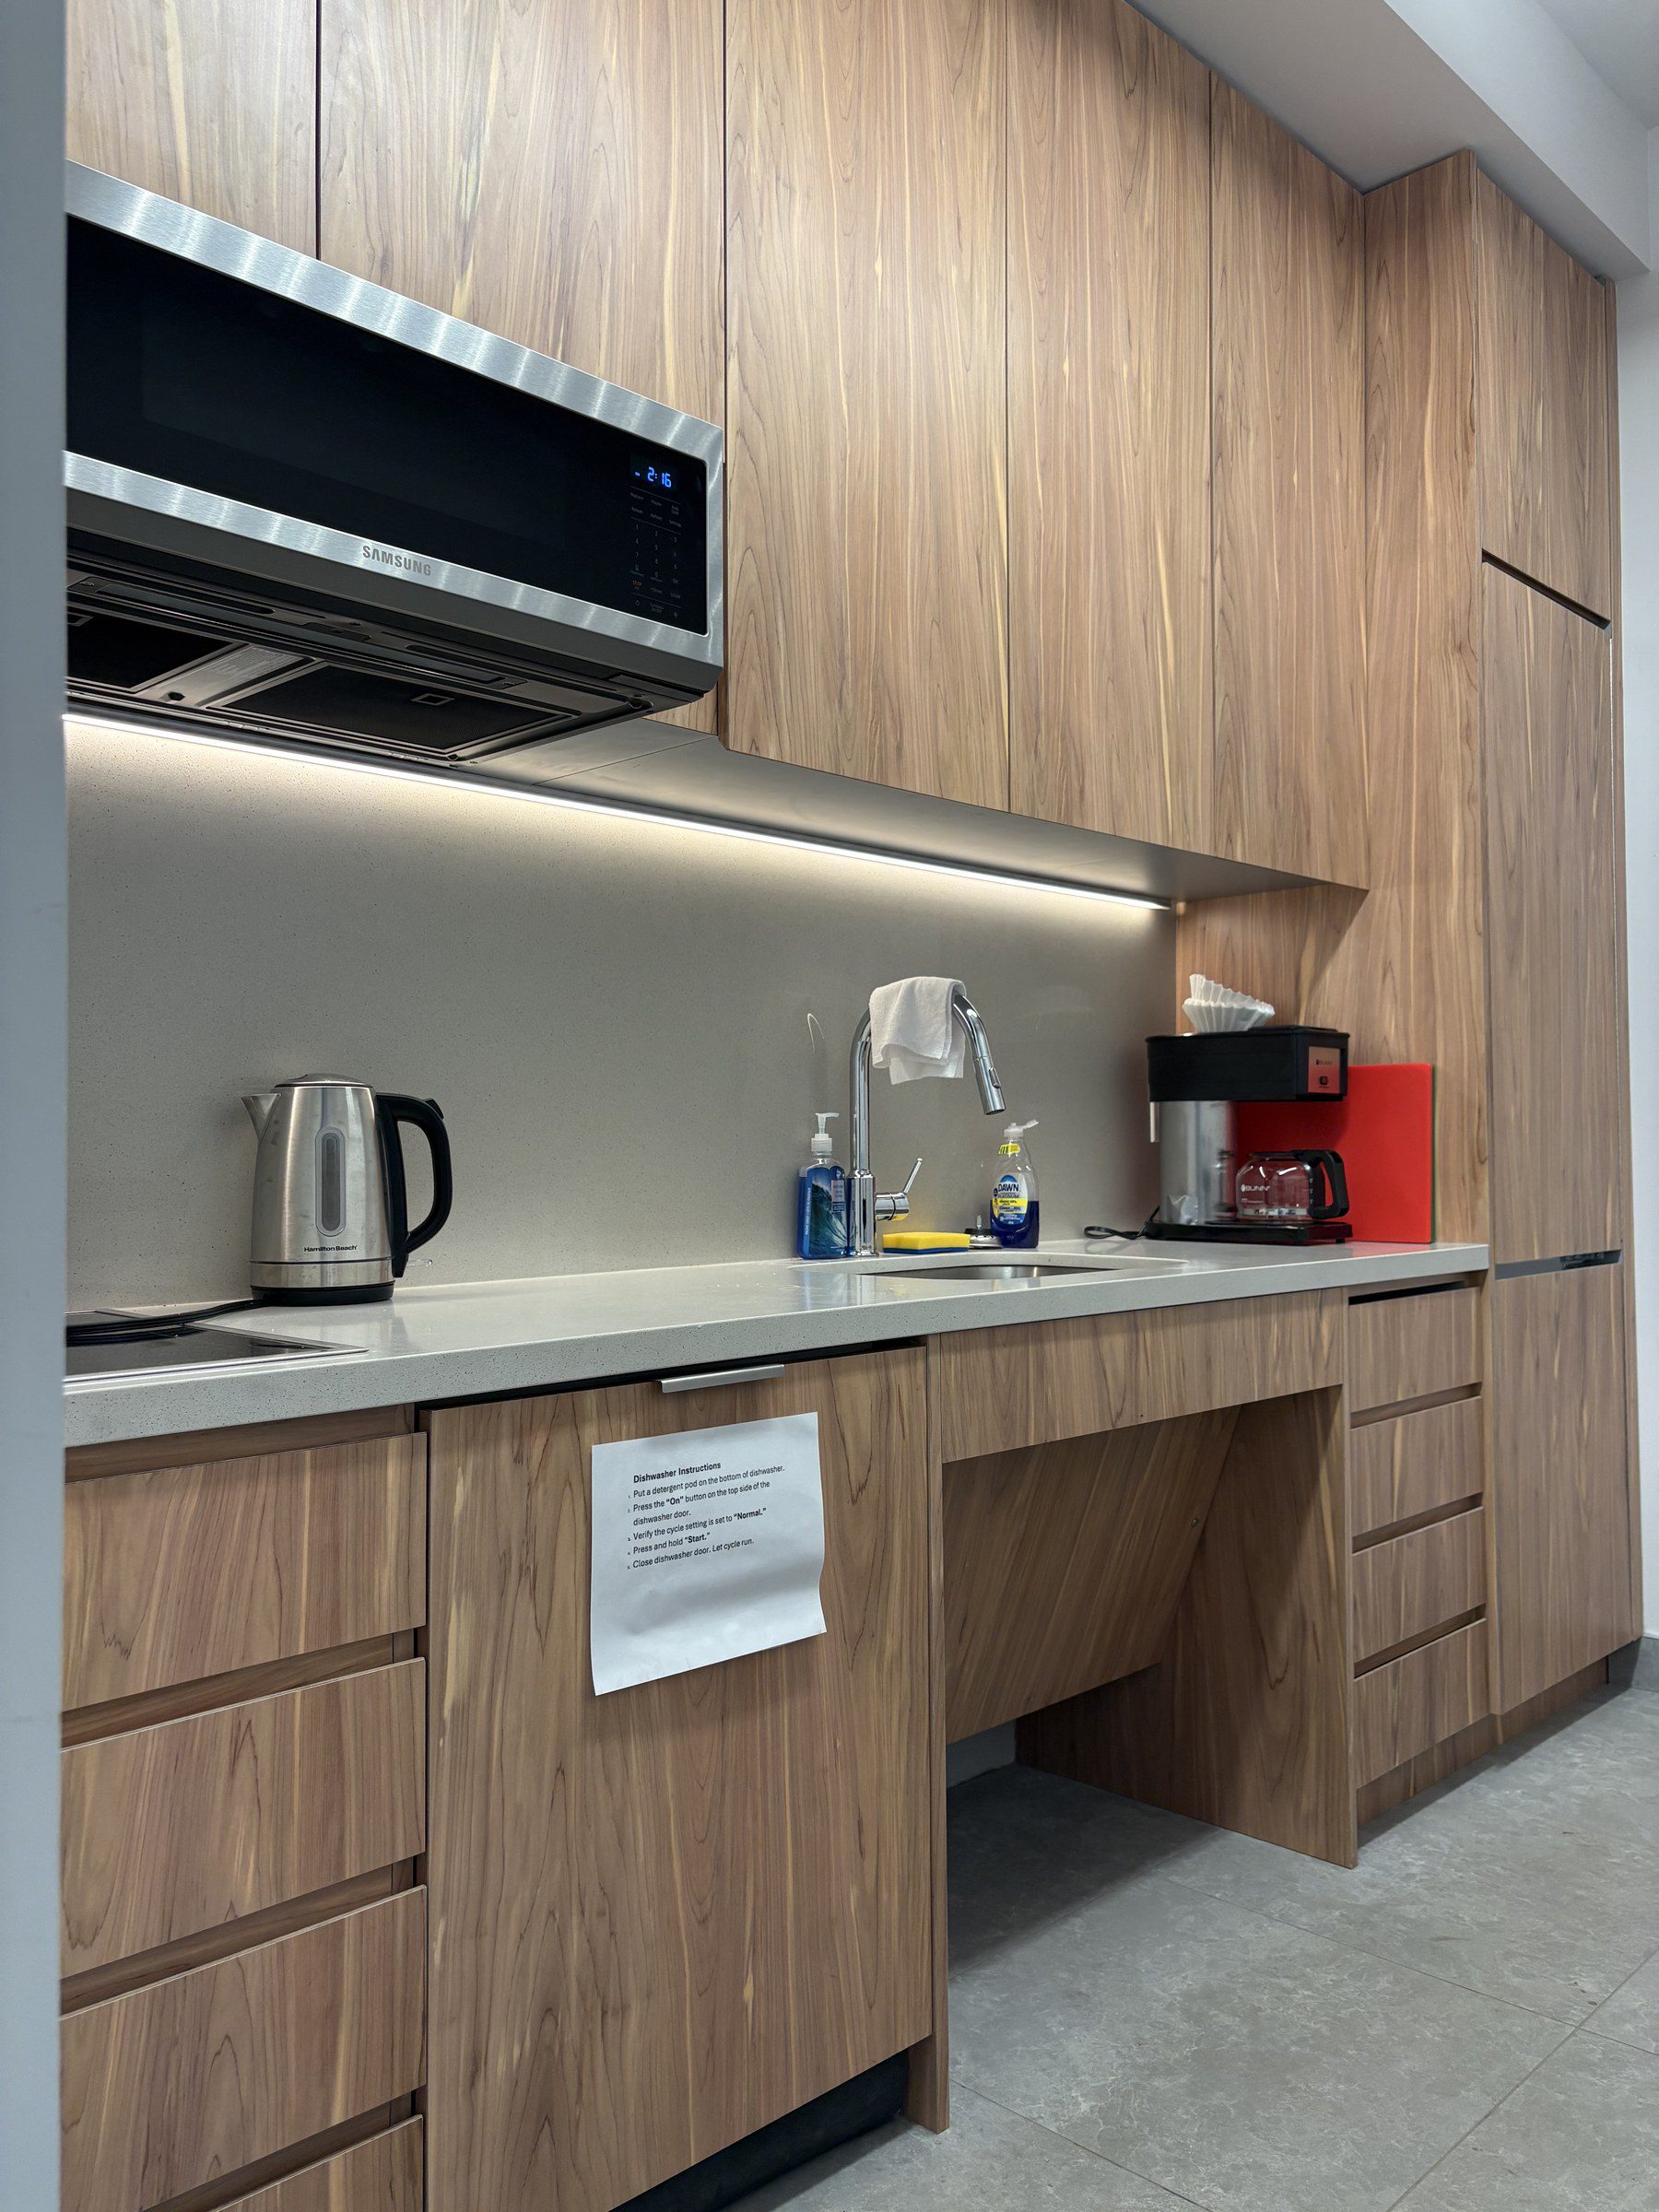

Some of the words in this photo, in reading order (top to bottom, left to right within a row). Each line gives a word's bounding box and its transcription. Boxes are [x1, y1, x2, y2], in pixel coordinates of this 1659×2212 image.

[362, 545, 431, 576] SAMSUNG
[998, 1184, 1019, 1192] DAWN
[634, 1470, 676, 1483] Dishwasher
[678, 1463, 721, 1475] Instructions
[652, 1483, 683, 1494] detergent
[685, 1480, 697, 1490] pod
[719, 1473, 741, 1482] bottom
[749, 1465, 785, 1477] dishwasher.
[633, 1503, 652, 1512] Press
[666, 1496, 684, 1505] “On”
[685, 1493, 706, 1502] button
[728, 1487, 738, 1496] top
[740, 1484, 752, 1492] side
[633, 1513, 672, 1526] dishwasher
[674, 1510, 691, 1519] door.
[633, 1530, 653, 1540] Verify
[667, 1524, 684, 1535] cycle
[685, 1520, 707, 1530] setting
[734, 1507, 766, 1520] “Normal.”
[633, 1545, 652, 1554] Press
[654, 1541, 667, 1550] and
[668, 1539, 683, 1547] hold
[685, 1532, 710, 1543] “Start.”
[633, 1559, 653, 1568] Close
[654, 1551, 693, 1564] dishwasher
[694, 1547, 711, 1555] door.
[724, 1541, 740, 1550] cycle
